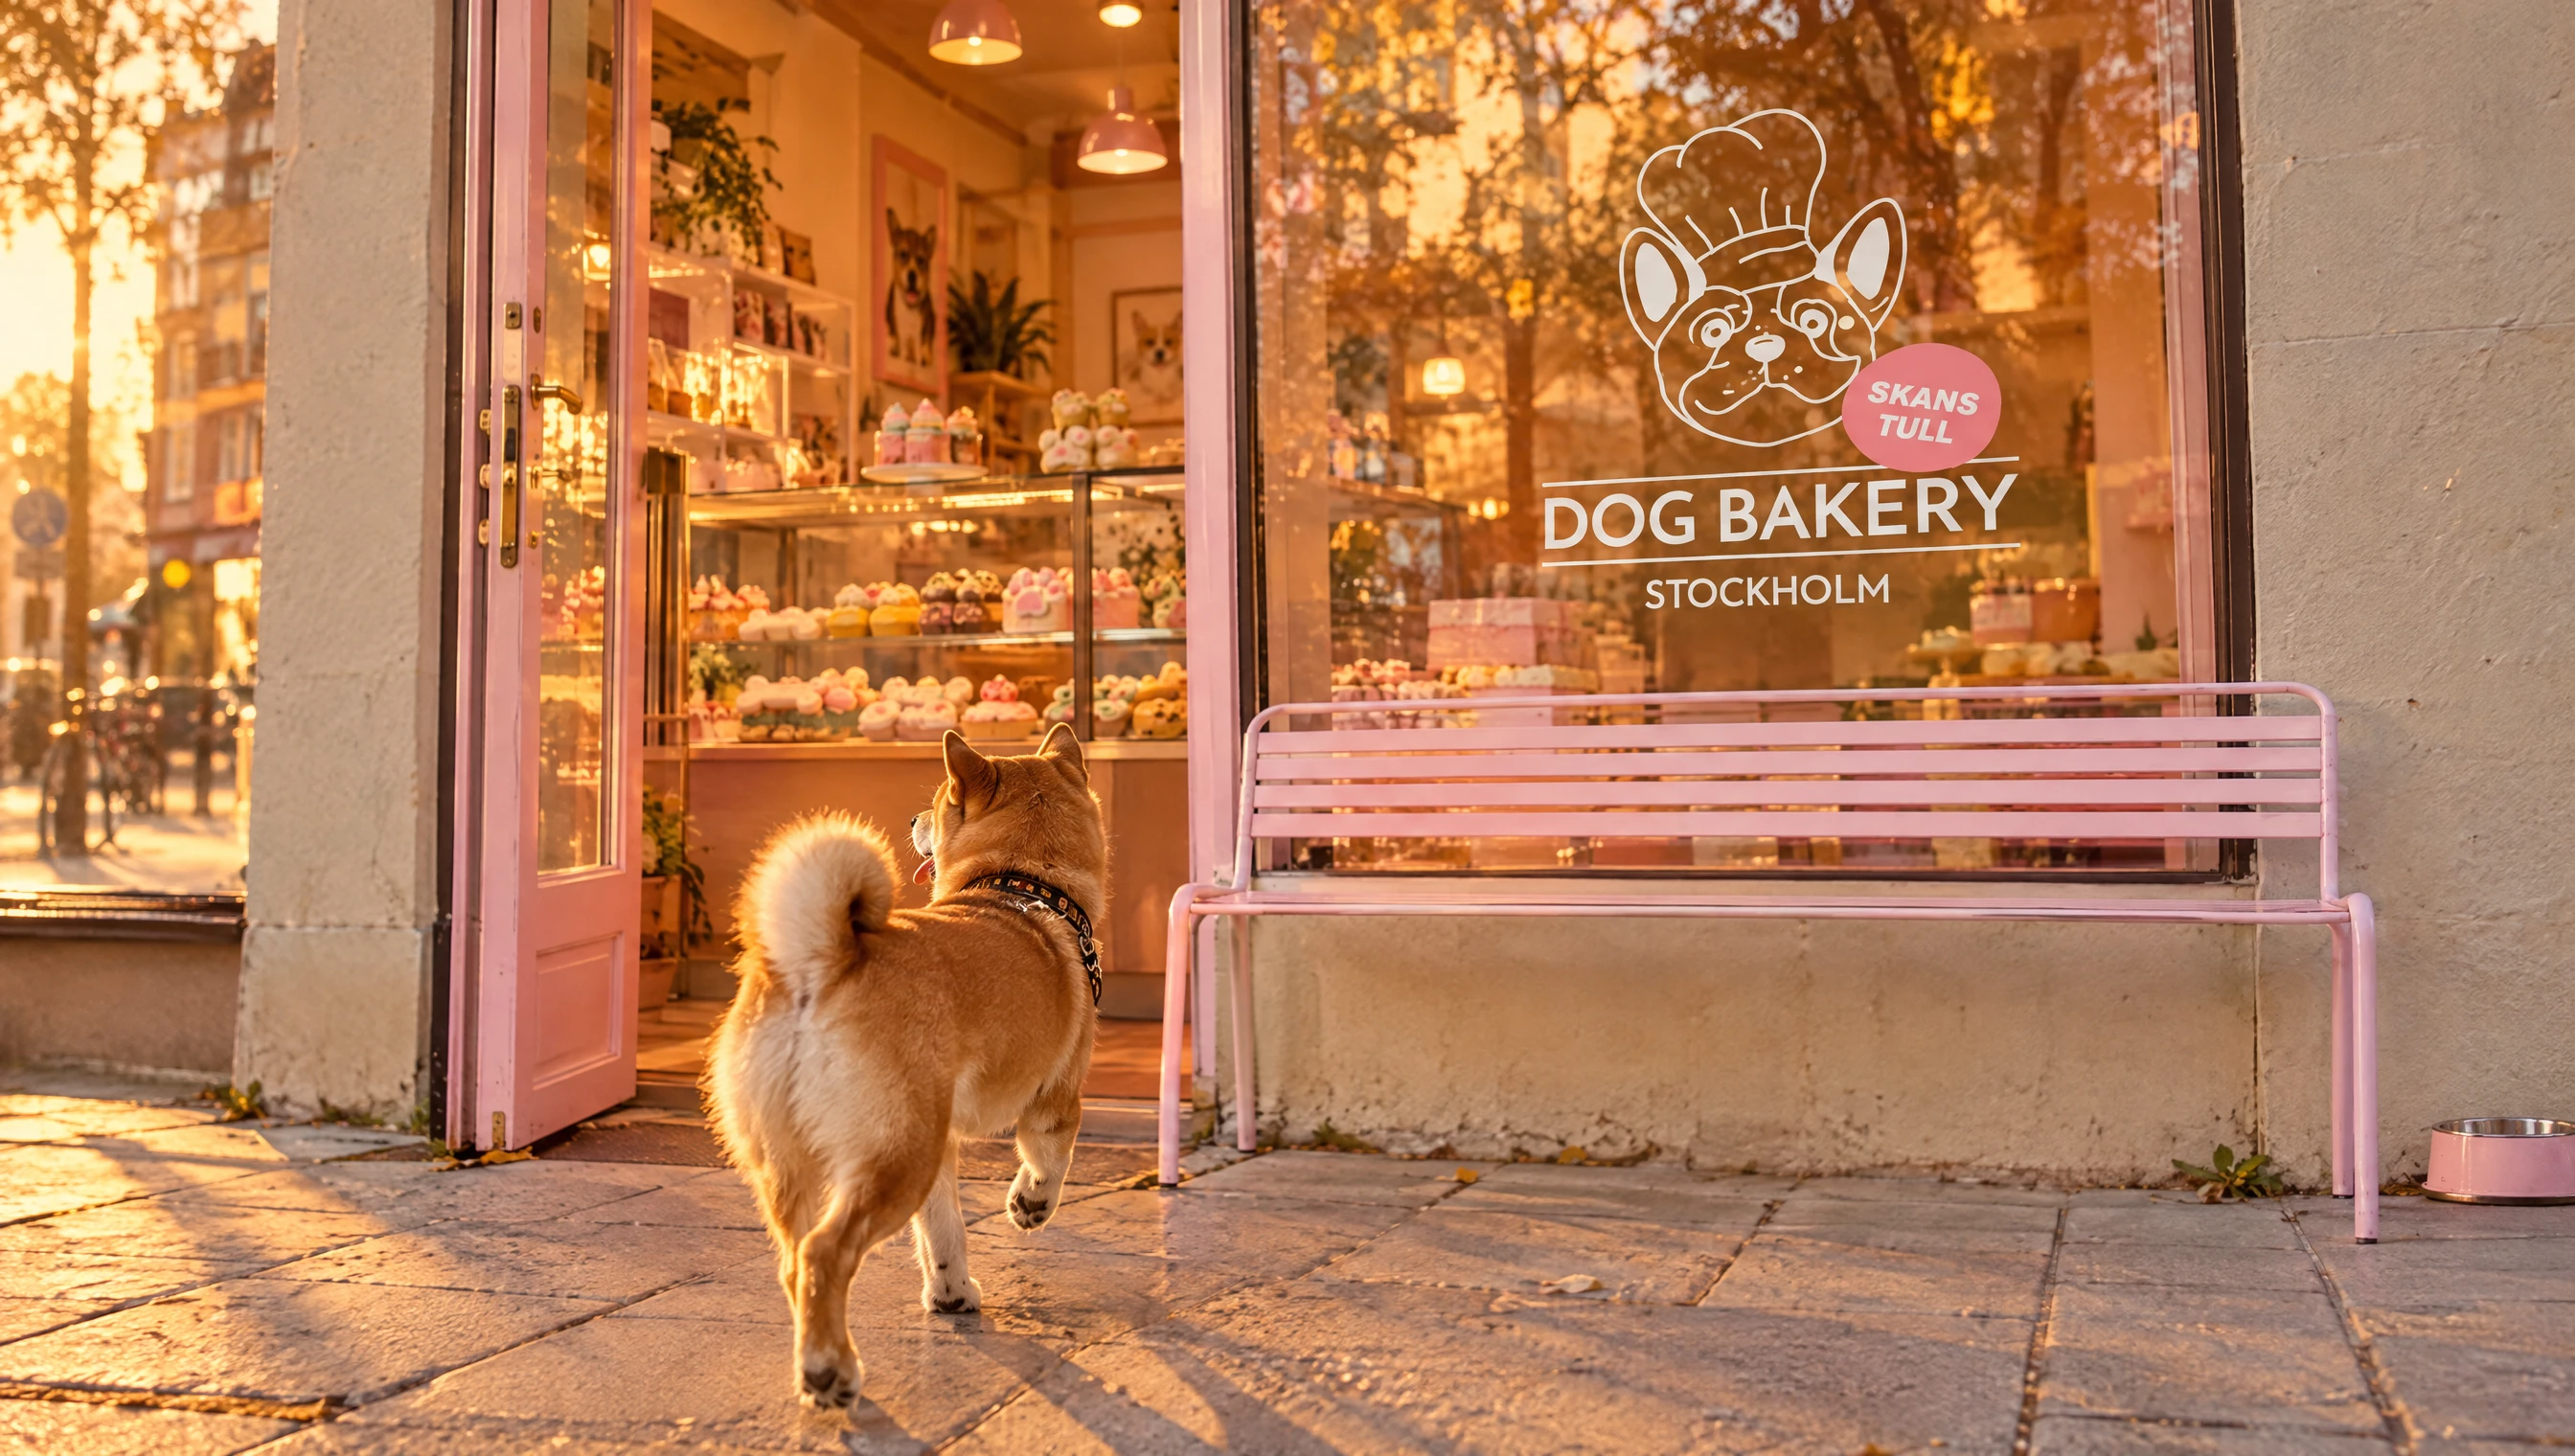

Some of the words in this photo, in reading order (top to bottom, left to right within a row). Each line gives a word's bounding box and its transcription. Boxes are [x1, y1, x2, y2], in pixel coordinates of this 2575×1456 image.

[1867, 380, 1980, 416] SKANS
[1879, 413, 1954, 444] TULL
[1544, 489, 1696, 550] DOG
[1720, 473, 2018, 543] BAKERY
[1645, 573, 1890, 610] STOCKHOLM
